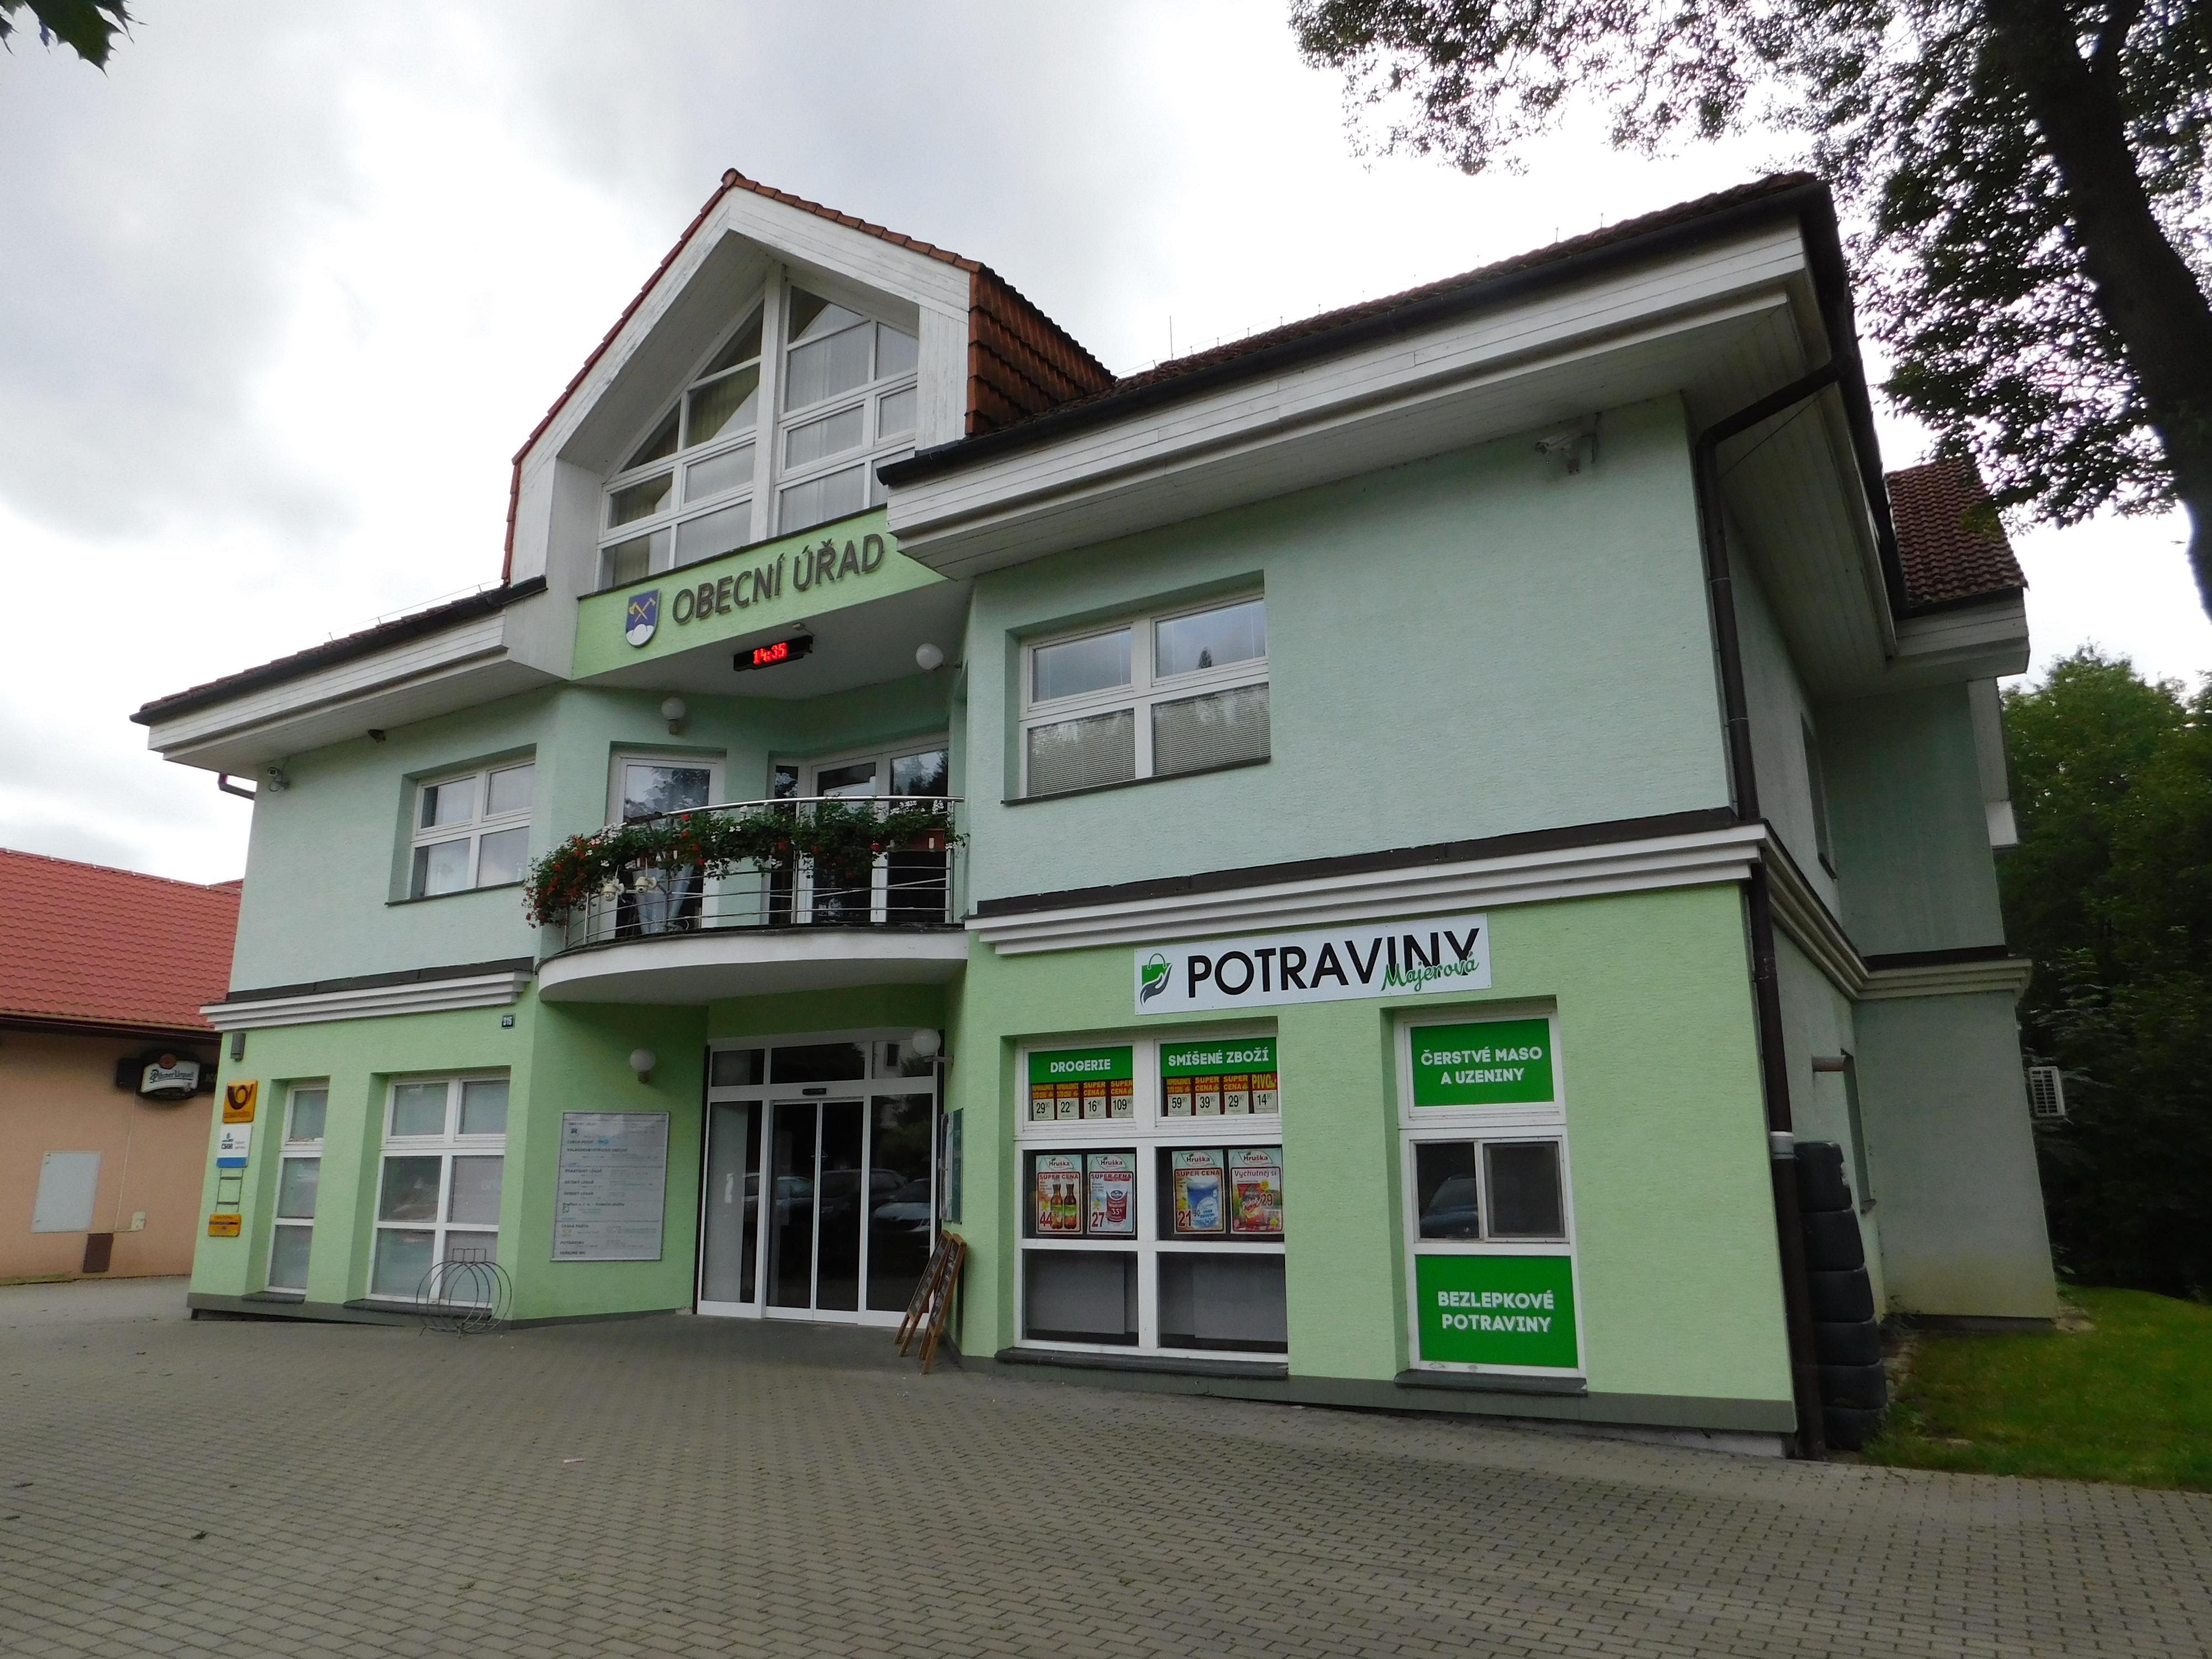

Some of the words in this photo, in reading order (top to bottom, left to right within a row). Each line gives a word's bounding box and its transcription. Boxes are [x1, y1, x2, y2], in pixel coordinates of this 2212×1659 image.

[672, 553, 785, 624] OBECNÍ
[792, 538, 884, 591] ÚŘAD
[753, 641, 787, 665] 14:35
[1187, 927, 1480, 998] POTRAVINY
[1380, 951, 1479, 992] Majerová
[1168, 1050, 1223, 1066] SMÍŠENÉ
[1226, 1047, 1269, 1063] ZBOŽÍ
[1421, 1046, 1491, 1065] ČERSTVÉ
[1495, 1046, 1542, 1062] MASO
[1050, 1058, 1111, 1073] DROGERIE
[1252, 1073, 1272, 1089] PIVO
[1441, 1072, 1452, 1084] A
[1455, 1068, 1525, 1084] UZENINY
[1088, 1100, 1097, 1112] 16
[1113, 1099, 1127, 1110] 109
[1172, 1097, 1182, 1109] 59
[1199, 1096, 1210, 1108] 39
[1228, 1095, 1238, 1107] 29
[1257, 1094, 1266, 1105] 14
[1036, 1102, 1046, 1114] 29
[1061, 1102, 1070, 1113] 22
[1234, 1170, 1269, 1178] Vychutnej
[1261, 1193, 1272, 1206] 29
[1040, 1212, 1052, 1227] 44
[1092, 1212, 1105, 1227] 27
[1178, 1210, 1191, 1227] 21
[1438, 1290, 1554, 1309] BEZLEPKOVÉ
[1442, 1313, 1552, 1332] POTRAVINY
